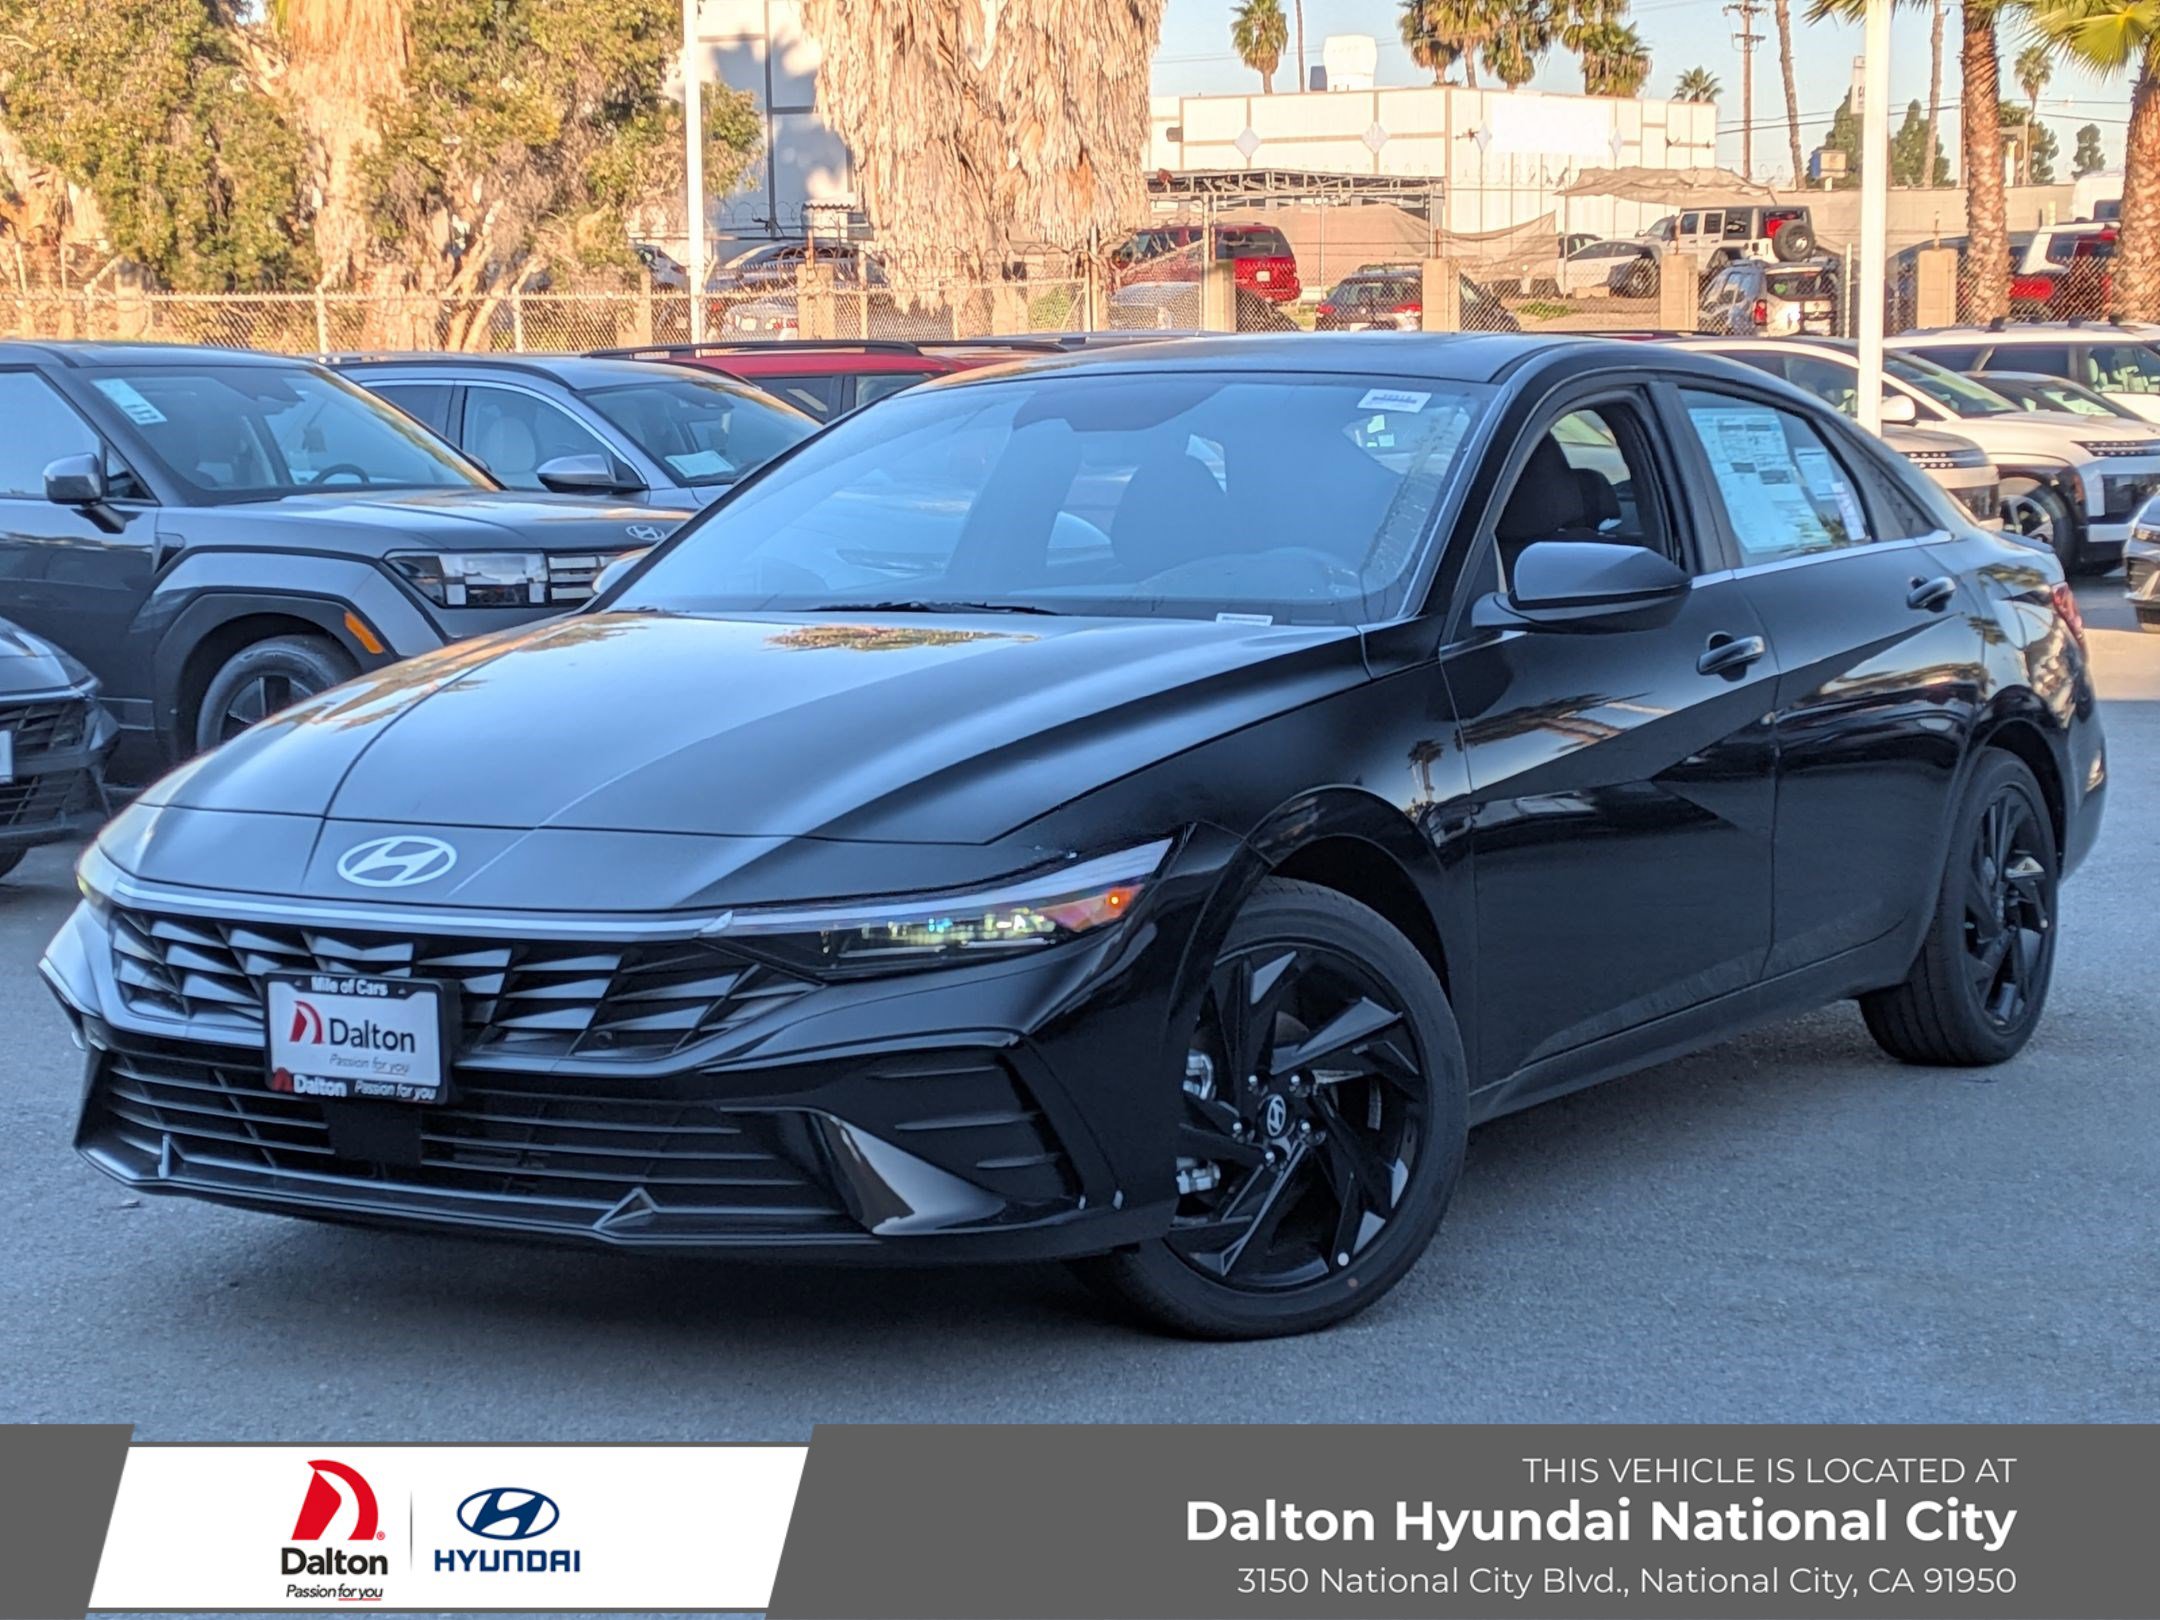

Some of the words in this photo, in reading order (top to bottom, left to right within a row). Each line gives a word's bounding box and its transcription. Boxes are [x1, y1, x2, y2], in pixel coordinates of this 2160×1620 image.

[311, 976, 339, 993] Mile
[340, 978, 355, 994] of
[356, 979, 389, 996] Cars
[330, 1018, 415, 1053] Dalton
[330, 1054, 369, 1069] Passion
[372, 1057, 387, 1074] for
[389, 1062, 410, 1074] you
[294, 1075, 347, 1097] Dalton
[355, 1080, 394, 1096] Passion
[396, 1083, 412, 1100] for
[413, 1088, 437, 1101] you
